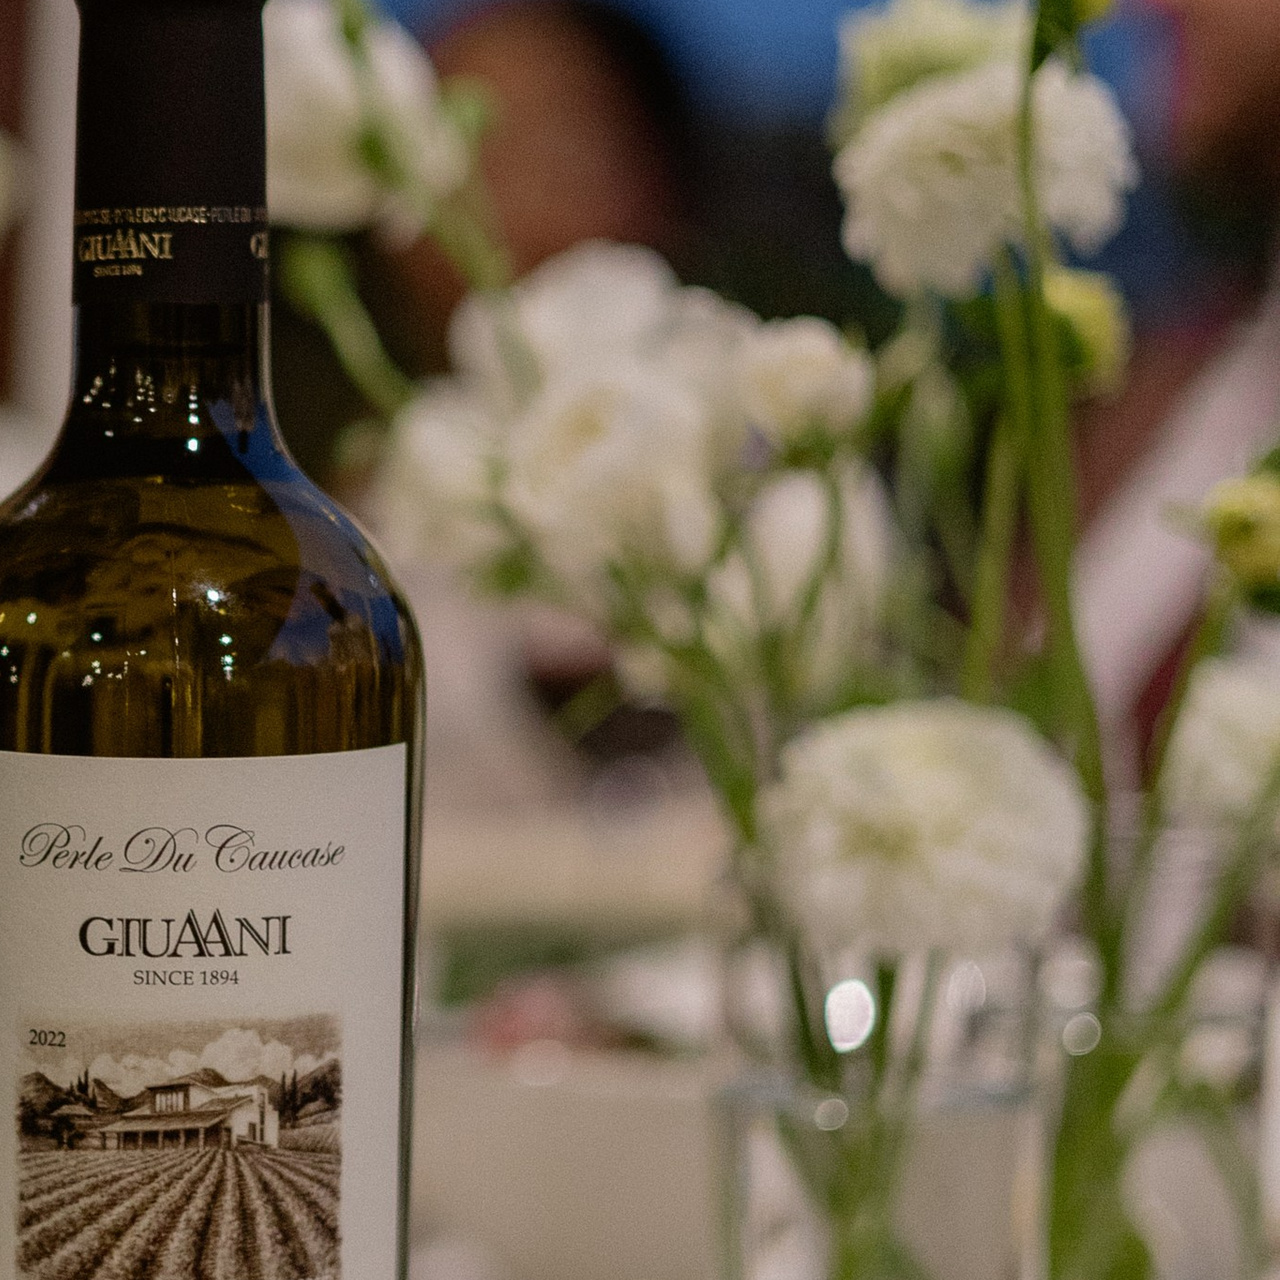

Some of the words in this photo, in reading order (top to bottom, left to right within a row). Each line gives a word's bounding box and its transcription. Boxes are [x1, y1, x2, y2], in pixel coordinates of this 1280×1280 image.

[19, 823, 114, 871] Perle
[118, 826, 199, 873] Du
[204, 823, 346, 873] Caucase
[78, 908, 292, 959] GIUAANI
[132, 969, 195, 987] SINCE
[199, 969, 240, 986] 1894
[28, 1027, 68, 1050] 2022
